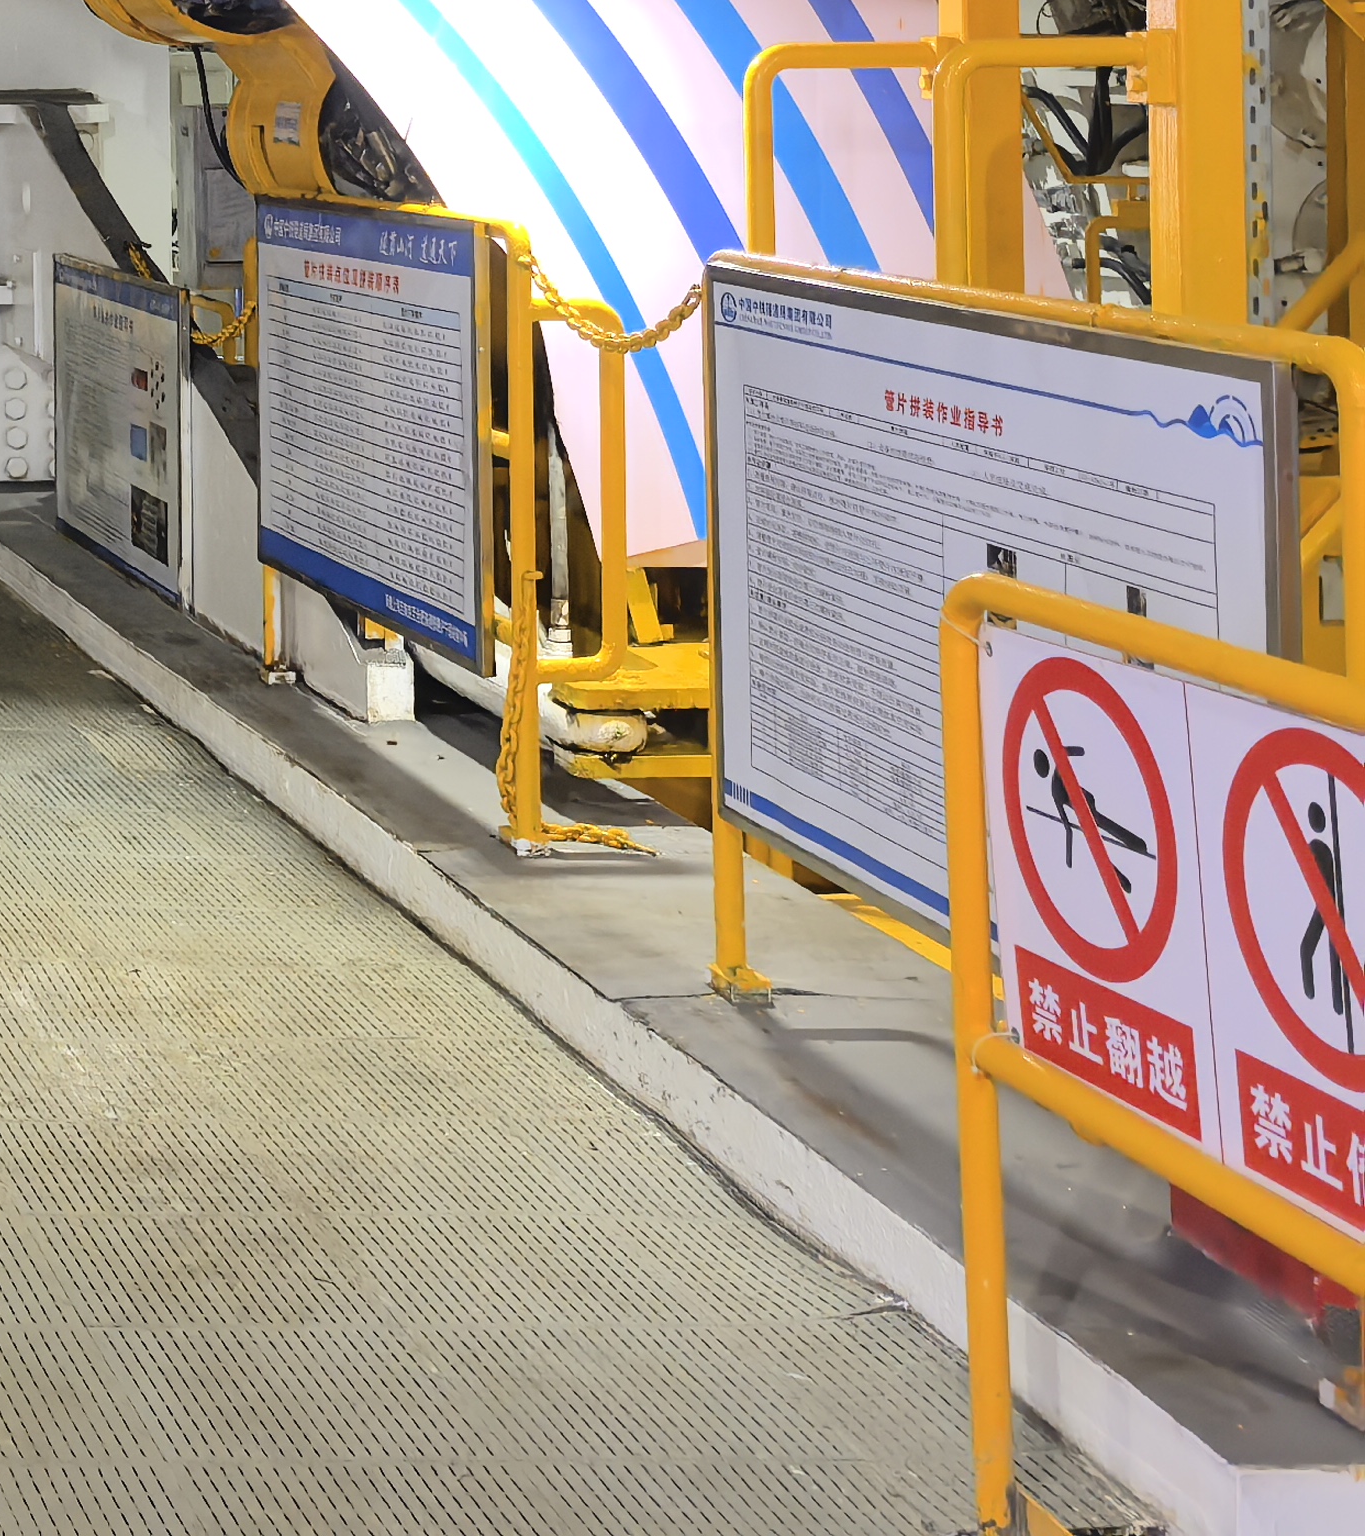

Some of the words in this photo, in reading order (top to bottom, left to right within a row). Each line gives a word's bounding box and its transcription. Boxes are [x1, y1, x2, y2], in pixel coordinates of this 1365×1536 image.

[884, 389, 1004, 437] 管片拼装作业指导书
[1027, 977, 1188, 1112] 禁止翻越
